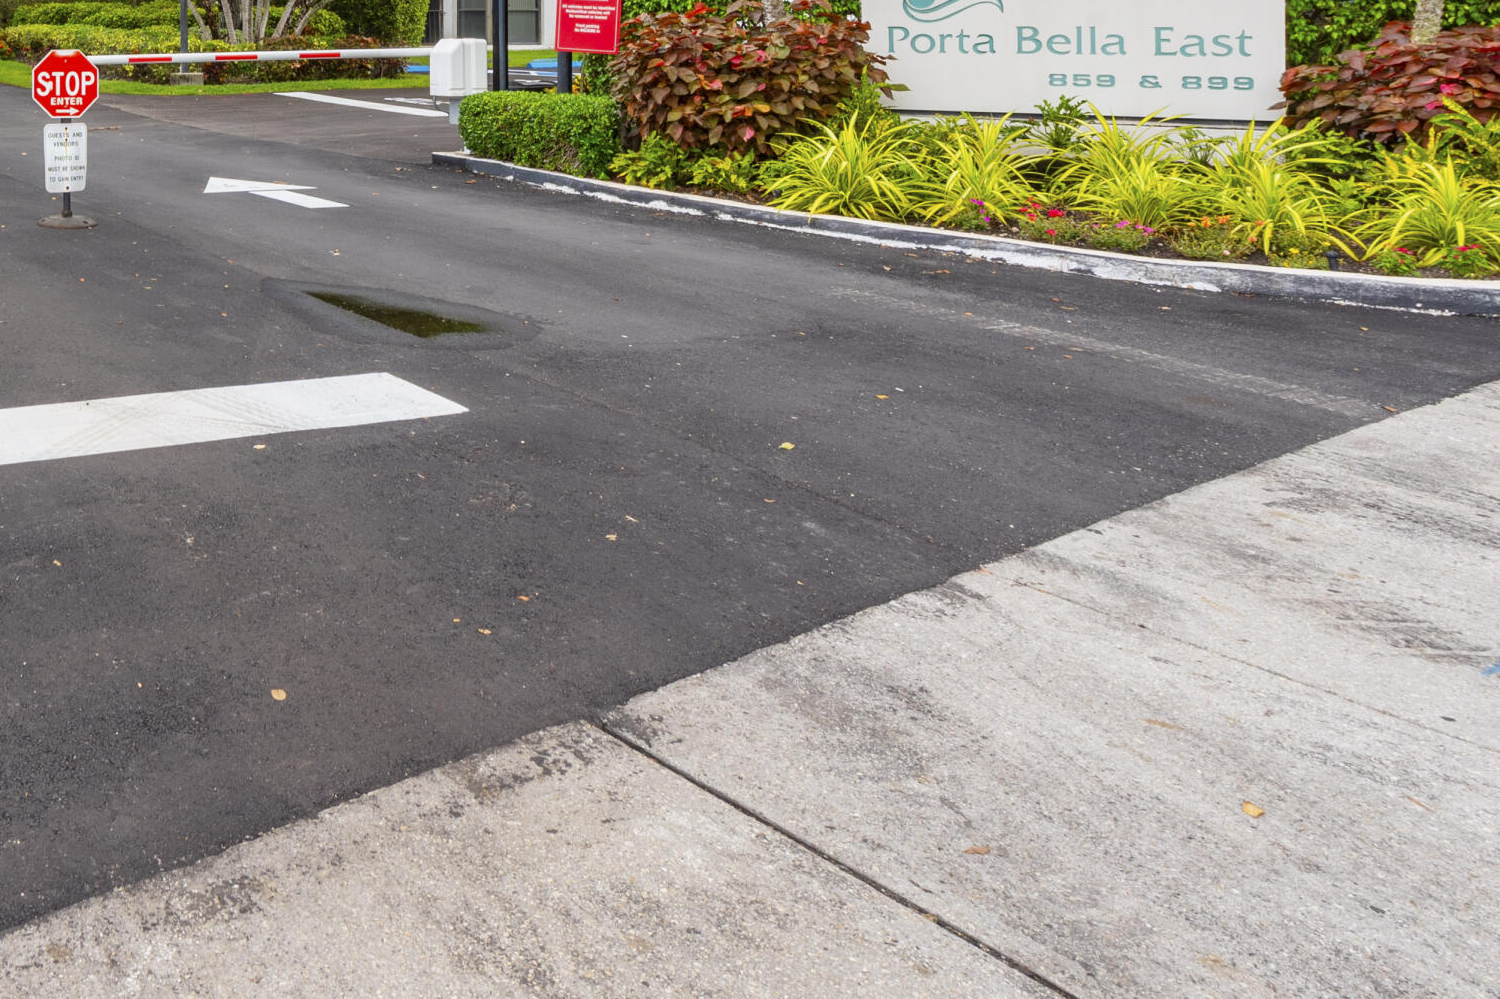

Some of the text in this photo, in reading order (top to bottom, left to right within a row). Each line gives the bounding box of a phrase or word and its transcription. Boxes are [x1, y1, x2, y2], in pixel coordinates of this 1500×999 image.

[887, 26, 1253, 57] Porta Bella East
[36, 71, 95, 96] STOP
[1048, 73, 1254, 90] 859 & 899
[50, 97, 83, 106] ENTER
